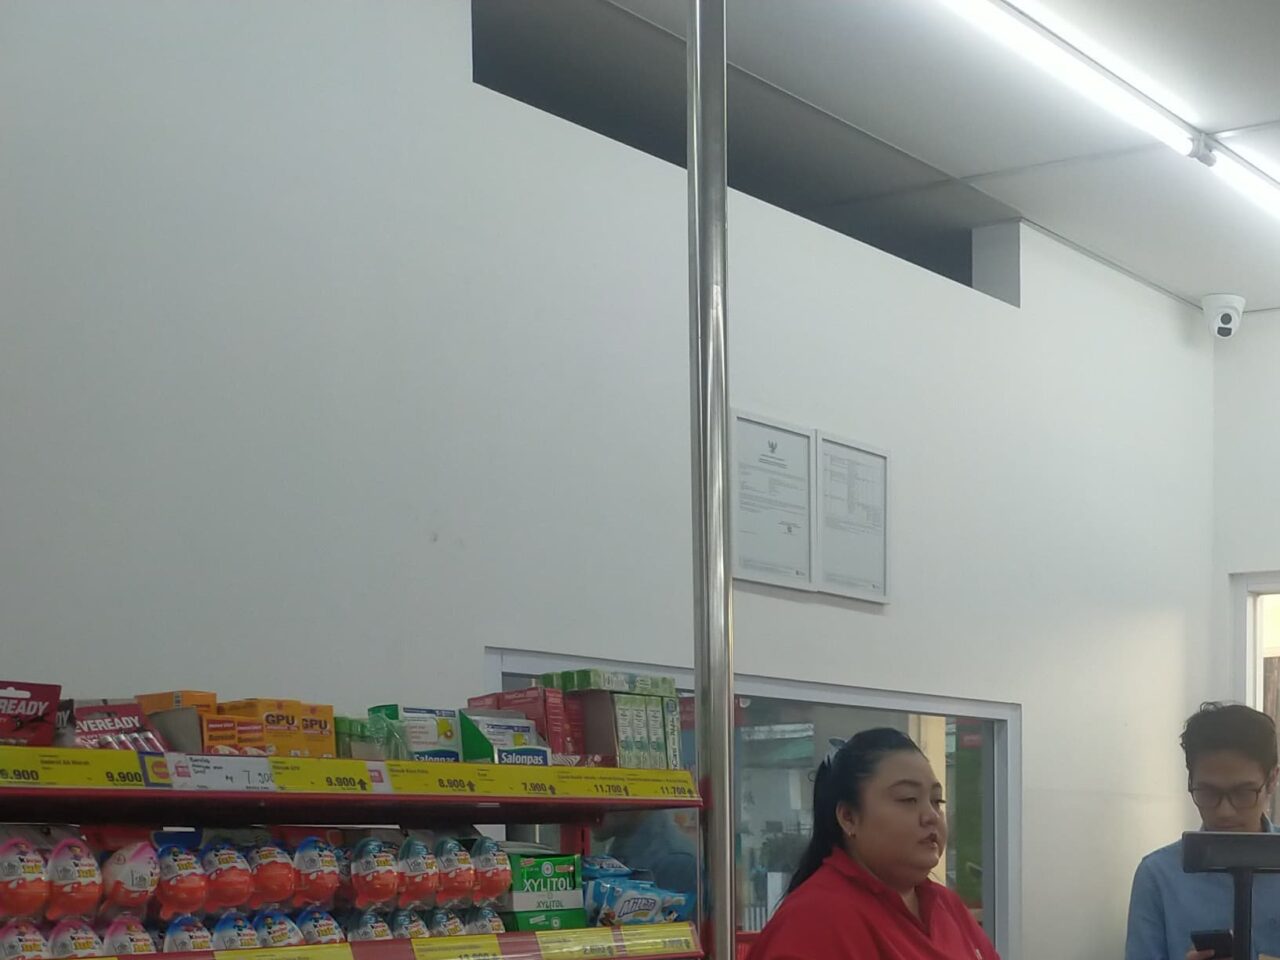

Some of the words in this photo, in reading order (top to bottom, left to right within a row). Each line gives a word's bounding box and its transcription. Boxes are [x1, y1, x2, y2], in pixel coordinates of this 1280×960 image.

[265, 714, 296, 726] GPU
[302, 718, 328, 731] GPU
[501, 752, 544, 766] Salonpas
[522, 877, 572, 892] XYLITOL
[536, 900, 564, 909] XYLITOL
